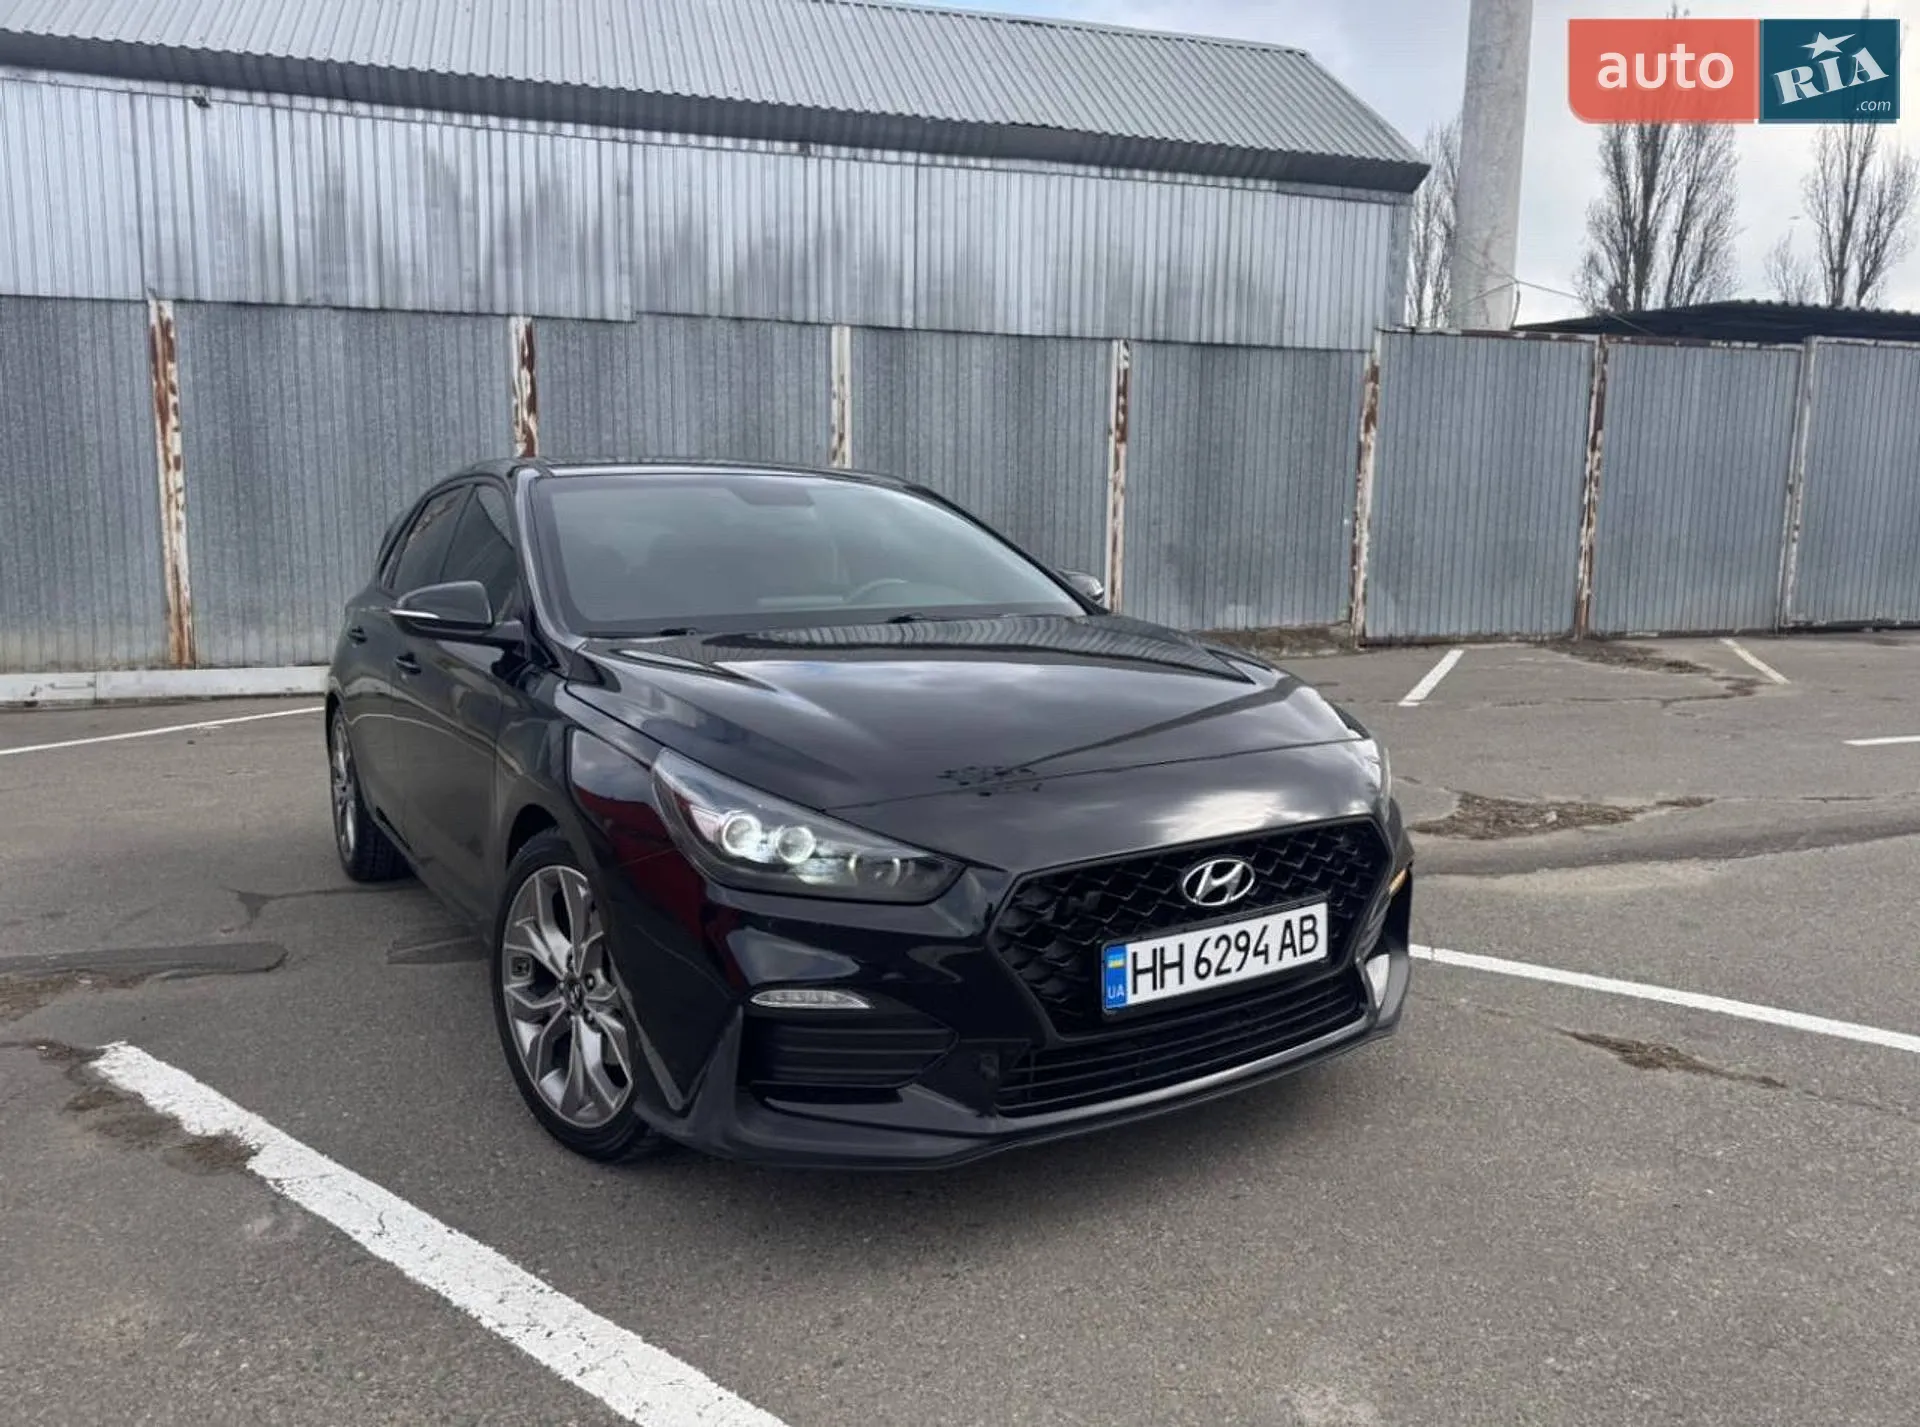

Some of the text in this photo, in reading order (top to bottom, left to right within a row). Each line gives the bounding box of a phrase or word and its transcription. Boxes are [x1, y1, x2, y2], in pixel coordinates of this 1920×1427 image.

[1132, 914, 1319, 995] HH 6294 AB
[1108, 985, 1125, 999] UA
